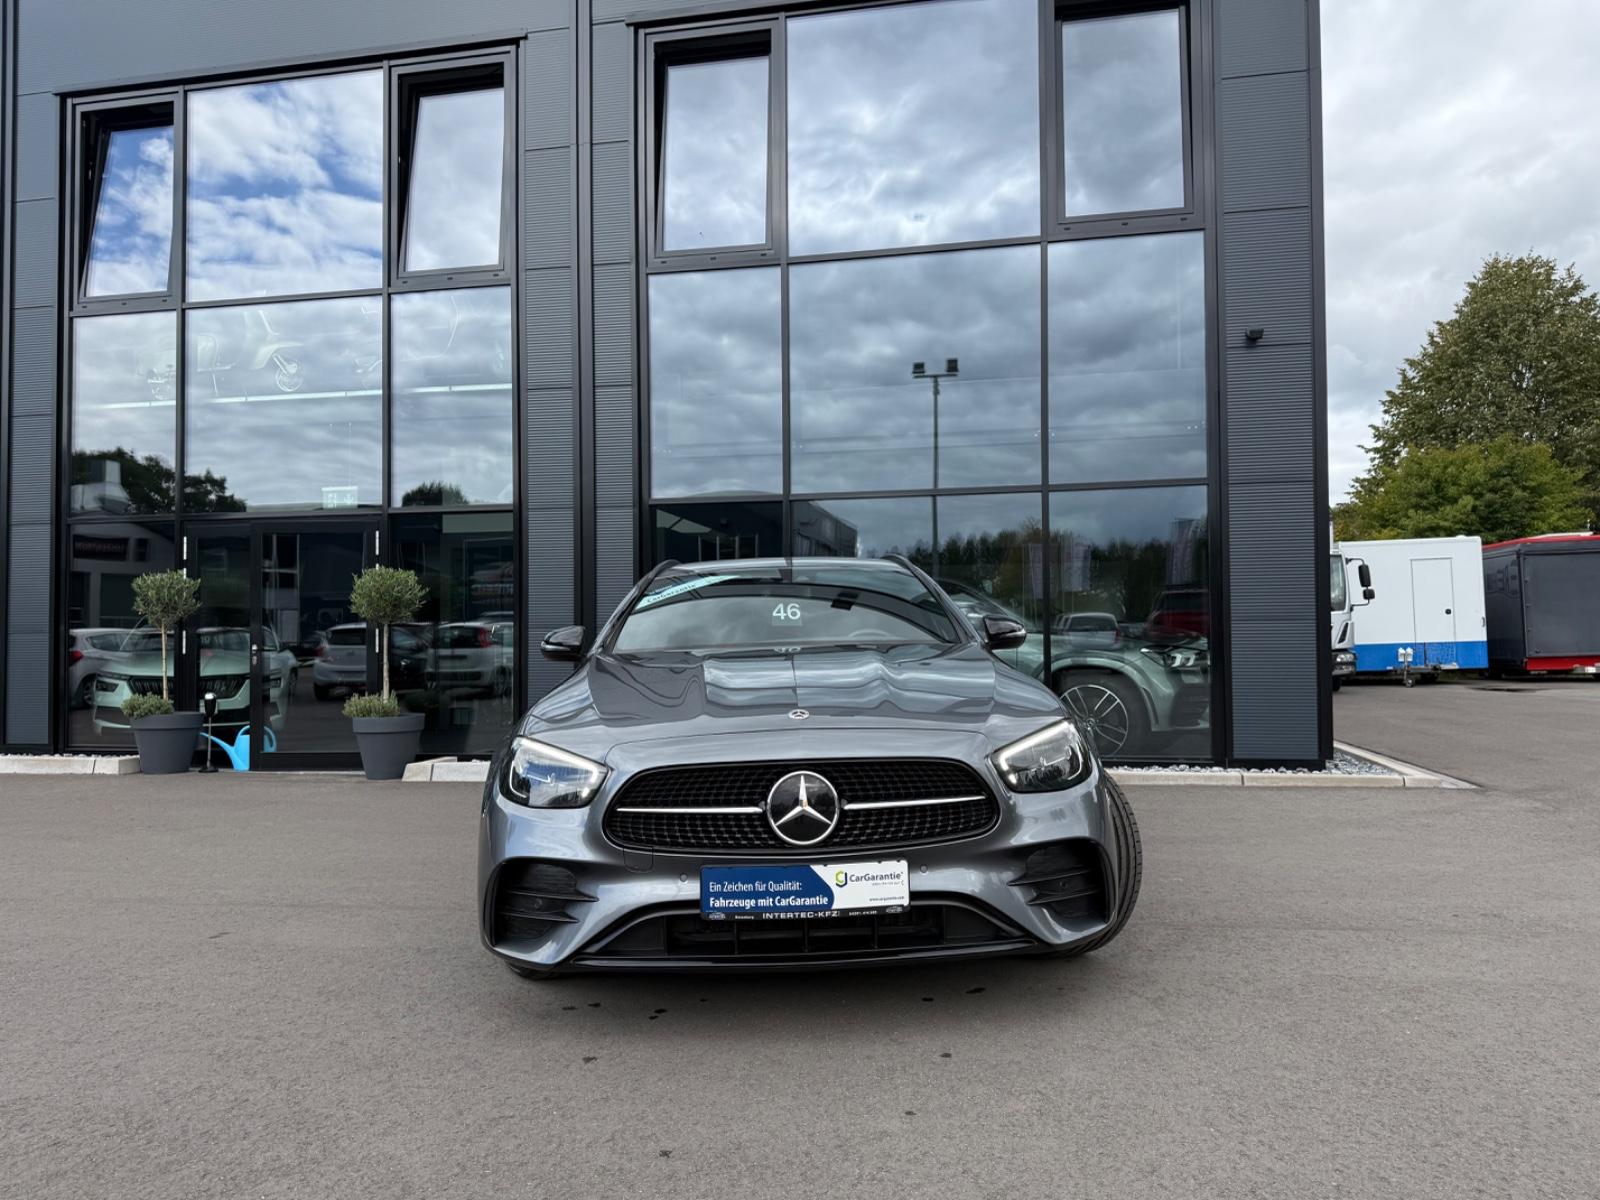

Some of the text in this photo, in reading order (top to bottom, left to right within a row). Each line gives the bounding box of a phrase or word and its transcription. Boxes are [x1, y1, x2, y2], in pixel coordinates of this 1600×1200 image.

[772, 603, 801, 620] 46
[849, 871, 902, 884] CarGarantie
[709, 880, 803, 892] Ein Zeichen für Qualität:
[709, 894, 829, 909] Fahrzeuge mit CarGarantie
